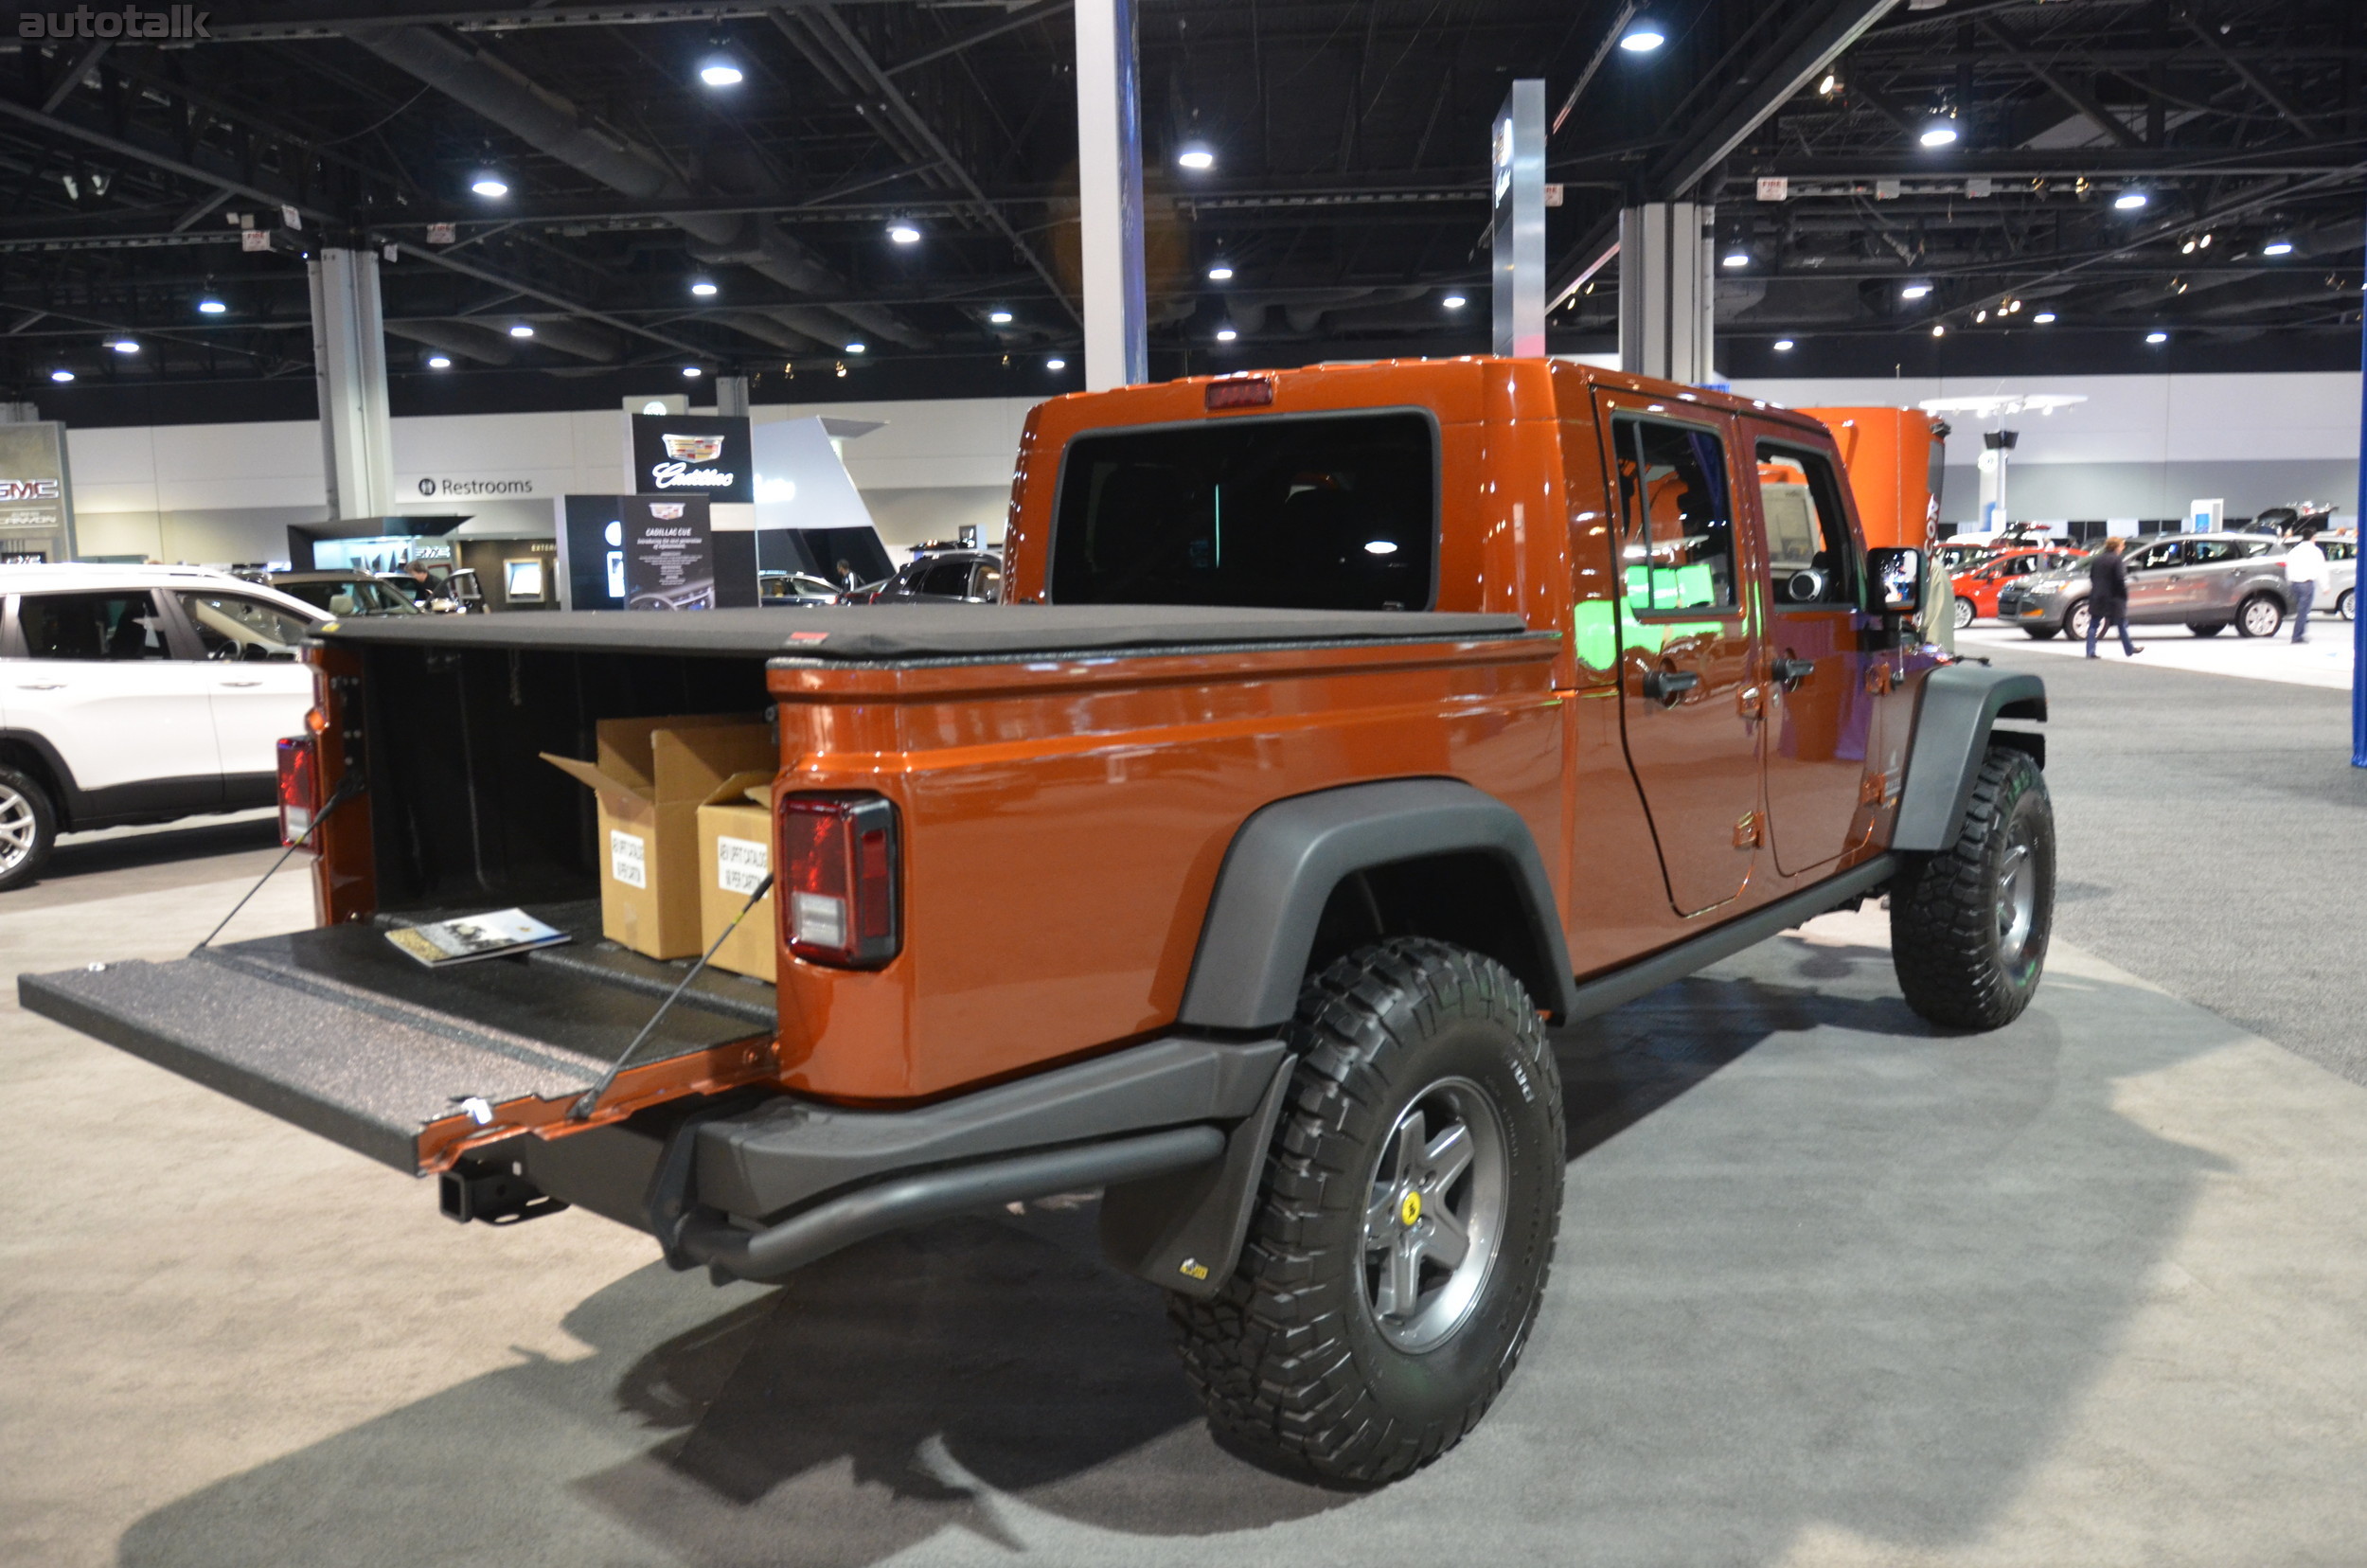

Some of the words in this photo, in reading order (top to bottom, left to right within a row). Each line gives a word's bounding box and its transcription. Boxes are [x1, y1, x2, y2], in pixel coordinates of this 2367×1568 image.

[651, 461, 734, 490] Cadillac
[441, 478, 533, 495] Restrooms
[645, 526, 678, 537] CADILLAC
